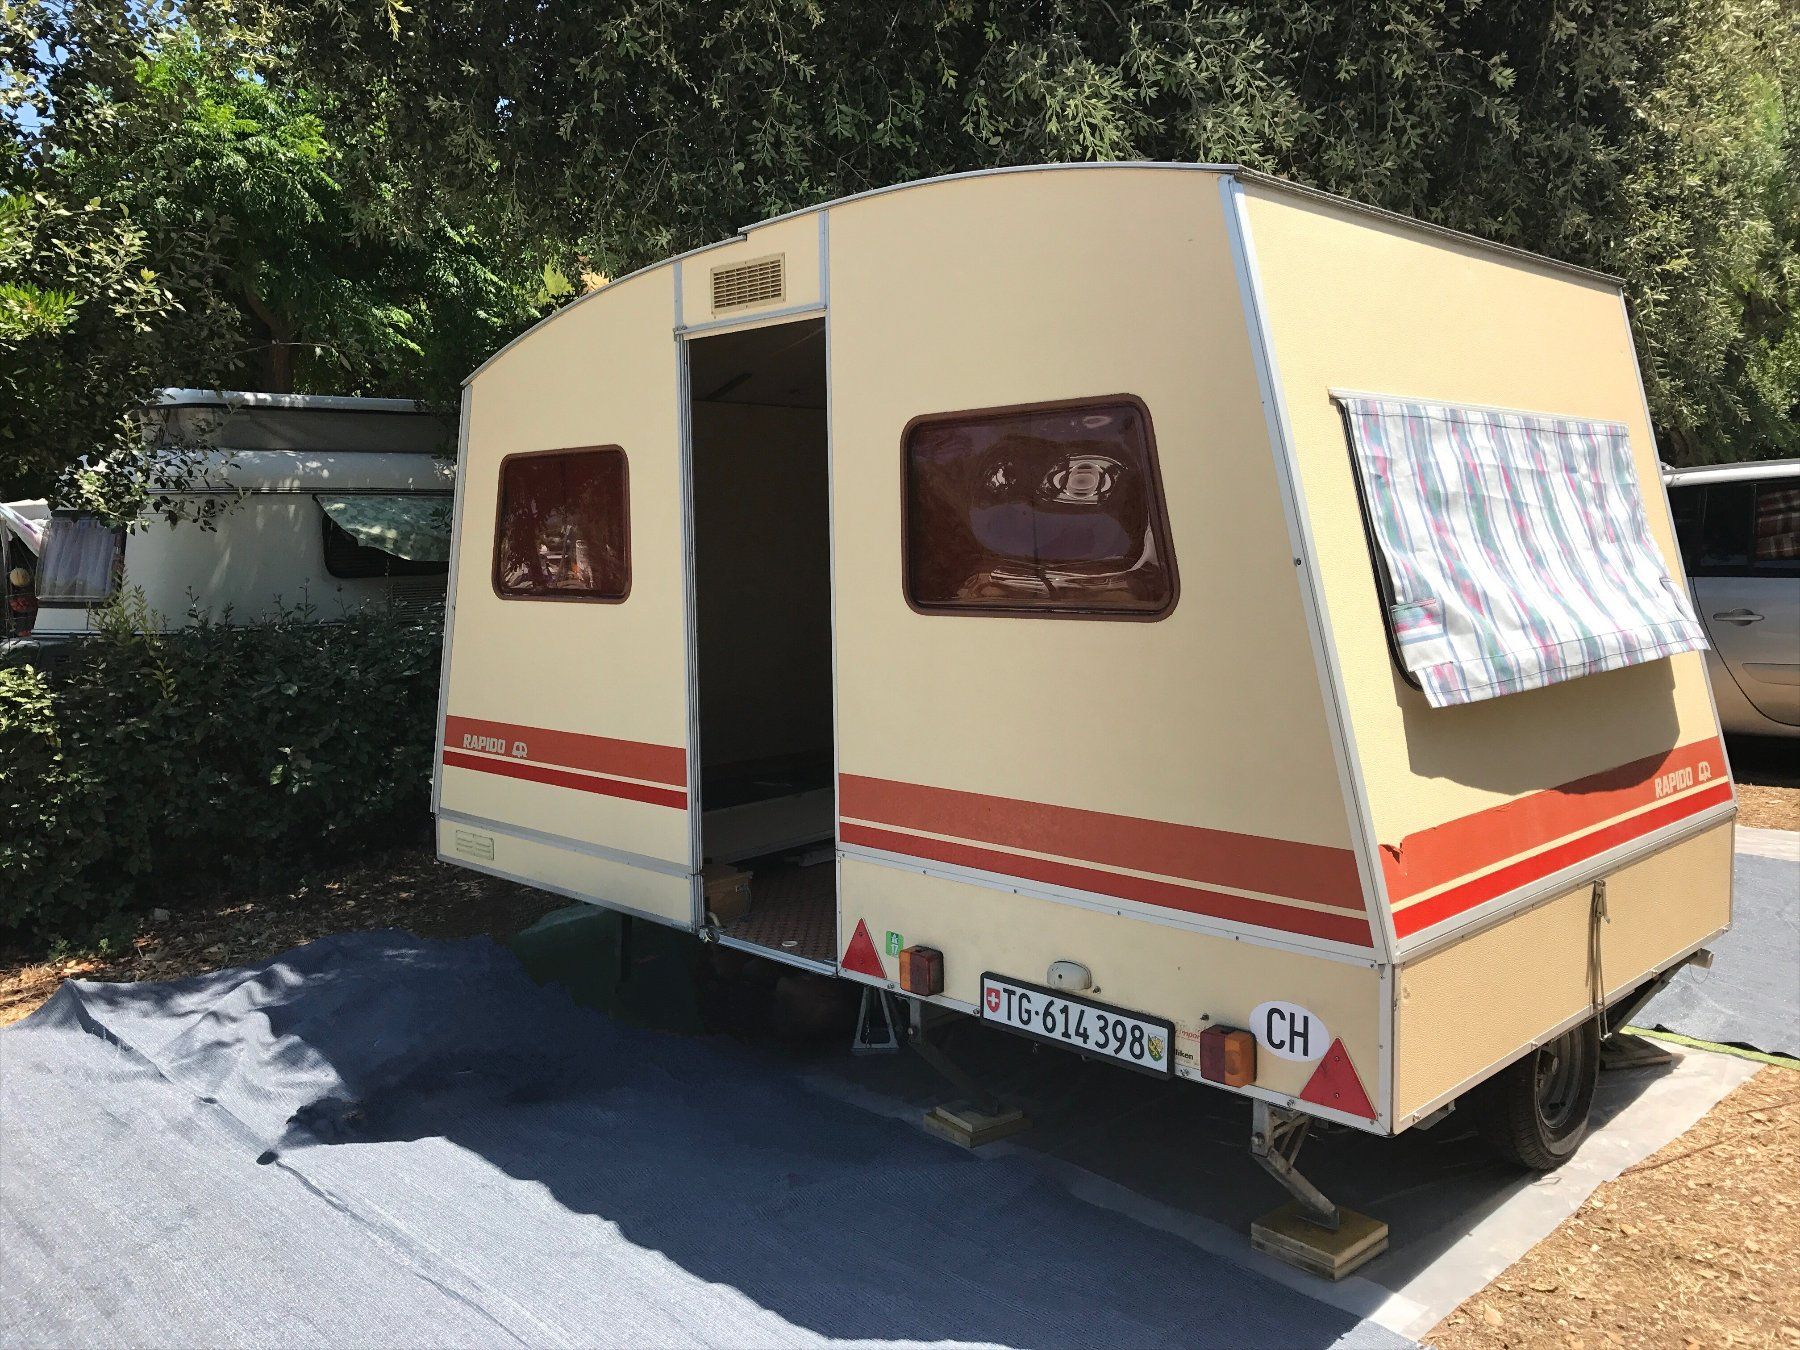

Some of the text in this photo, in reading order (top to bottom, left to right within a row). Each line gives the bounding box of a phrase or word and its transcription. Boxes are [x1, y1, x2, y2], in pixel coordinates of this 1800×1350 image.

[463, 733, 506, 755] RAPIDO
[1654, 766, 1694, 799] RAPIDO
[1266, 1007, 1309, 1057] CH
